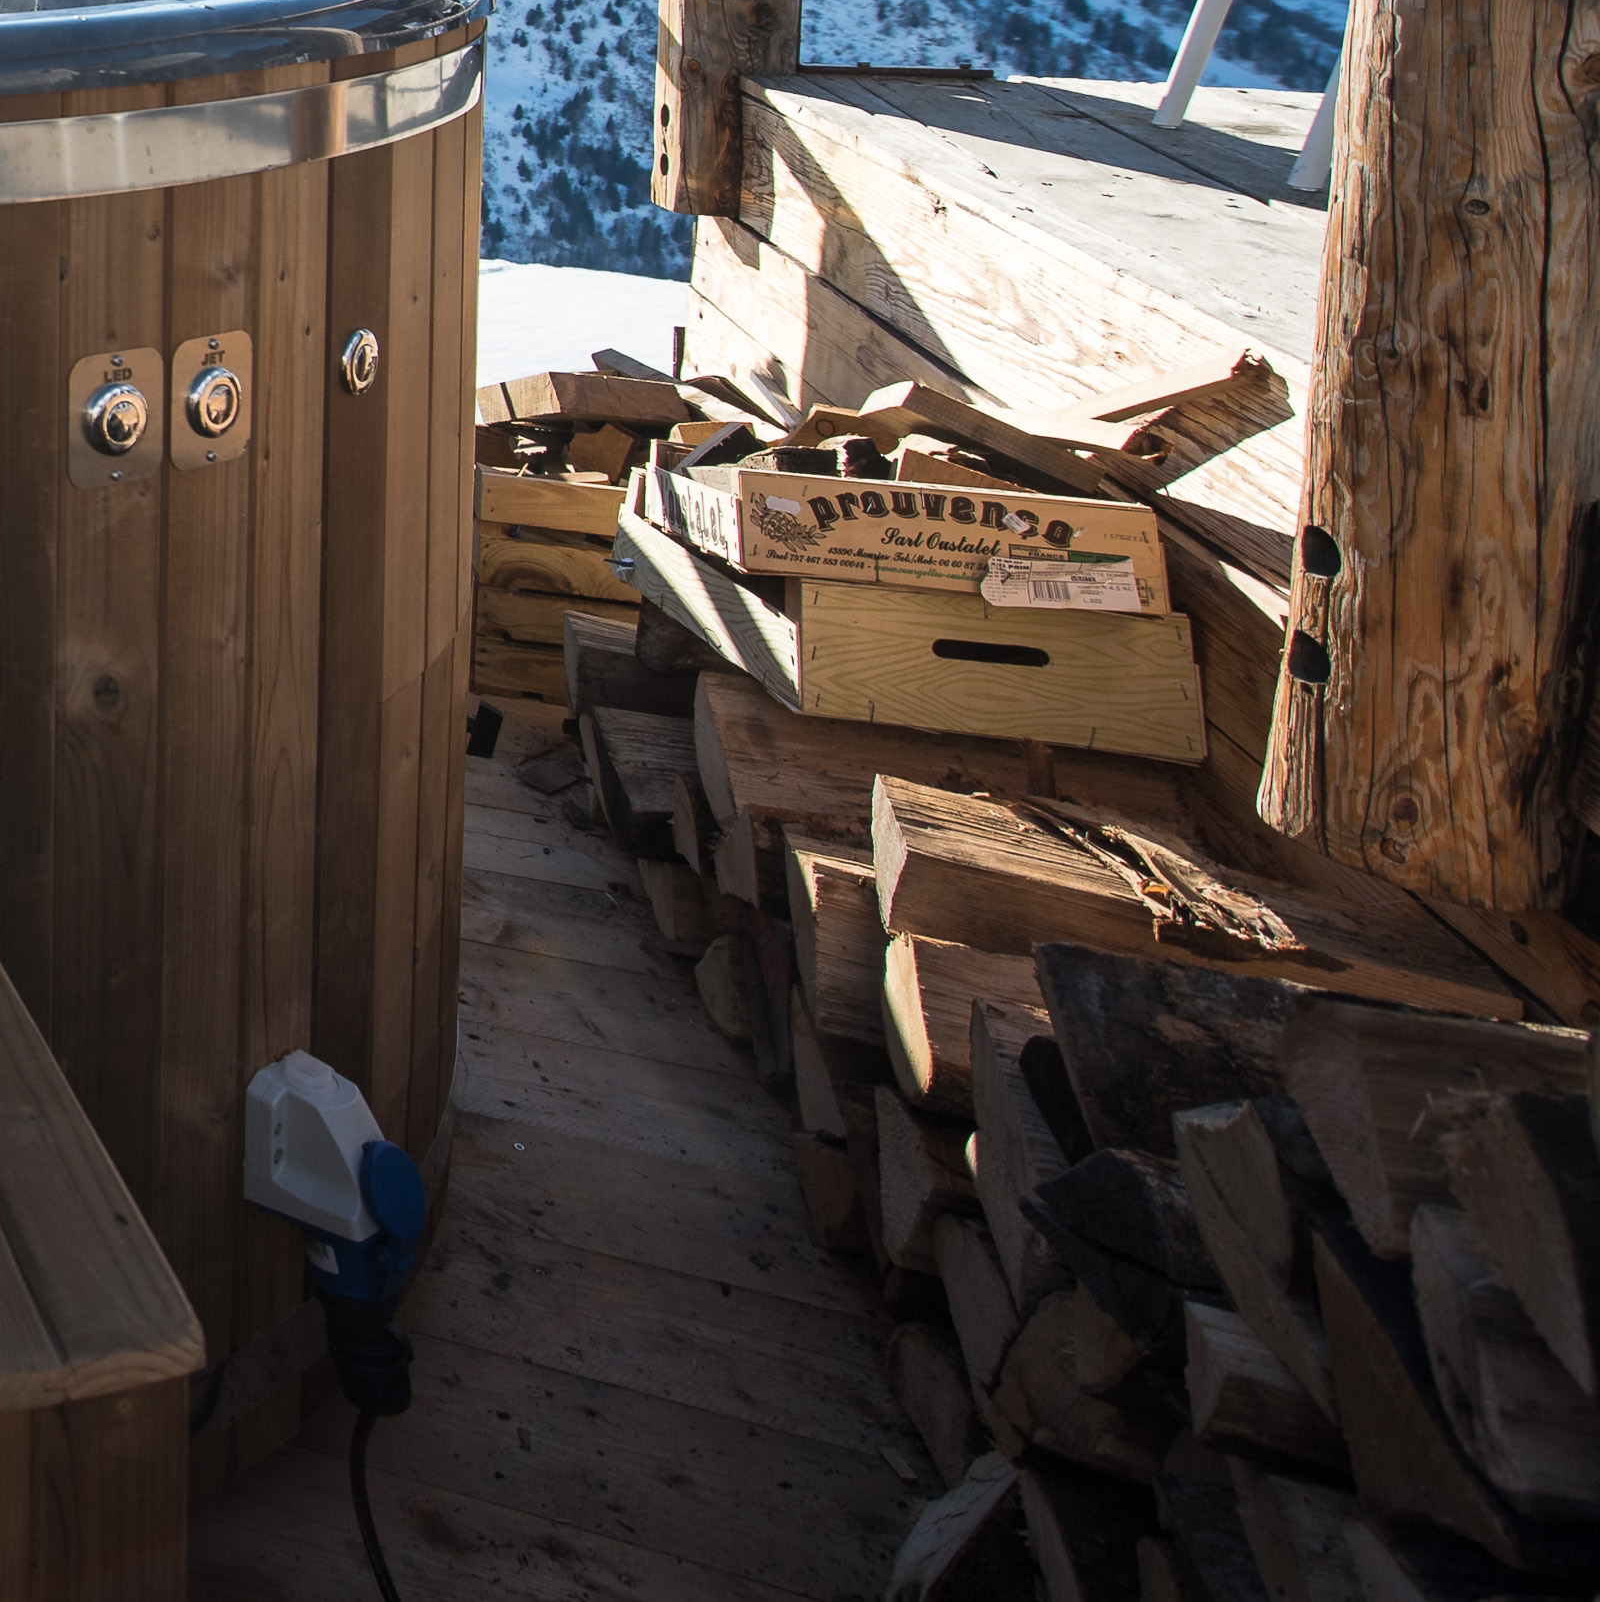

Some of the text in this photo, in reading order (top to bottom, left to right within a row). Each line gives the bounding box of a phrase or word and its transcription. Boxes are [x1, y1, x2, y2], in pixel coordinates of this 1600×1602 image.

[202, 349, 226, 366] JET
[103, 367, 133, 383] LED
[880, 527, 1002, 556] Sarl Oustalet
[790, 554, 803, 563] 797
[805, 555, 821, 565] 467
[828, 546, 853, 556] 13890
[938, 559, 950, 567] 06
[951, 560, 962, 568] 60
[963, 561, 975, 570] 87
[1028, 551, 1065, 561] FRANCE
